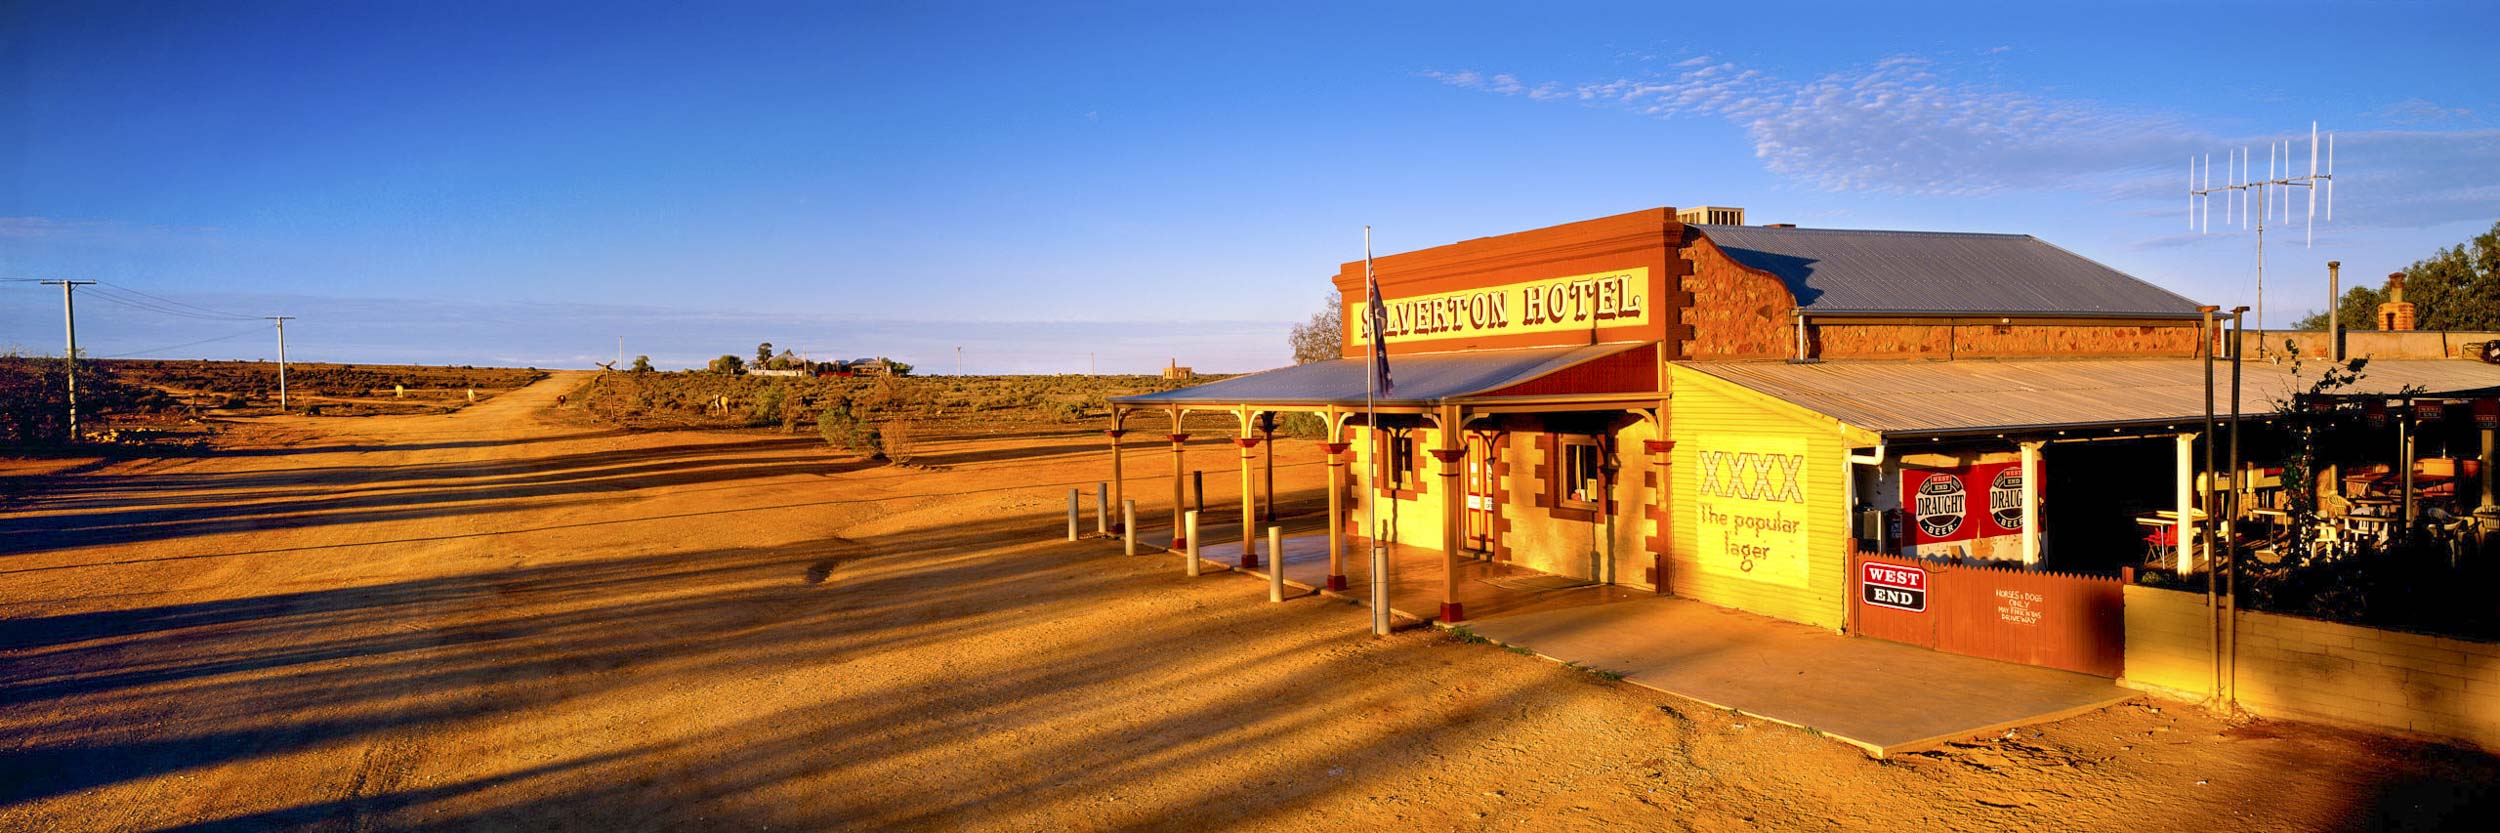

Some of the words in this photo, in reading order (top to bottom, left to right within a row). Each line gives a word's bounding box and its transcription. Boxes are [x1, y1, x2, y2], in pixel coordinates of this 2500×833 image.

[1361, 290, 1509, 338] SLVERTON
[1522, 274, 1641, 325] HOTEL
[1699, 450, 1804, 504] XXXX
[1918, 495, 1965, 516] DRAUGHT
[1992, 489, 2023, 509] DRAUG
[1701, 504, 1728, 525] The
[1734, 511, 1800, 538] popular
[1928, 525, 1955, 536] BEER
[1724, 531, 1771, 572] lager
[1868, 567, 1920, 586] WEST
[1873, 588, 1913, 605] END
[2008, 599, 2030, 608] ONLY
